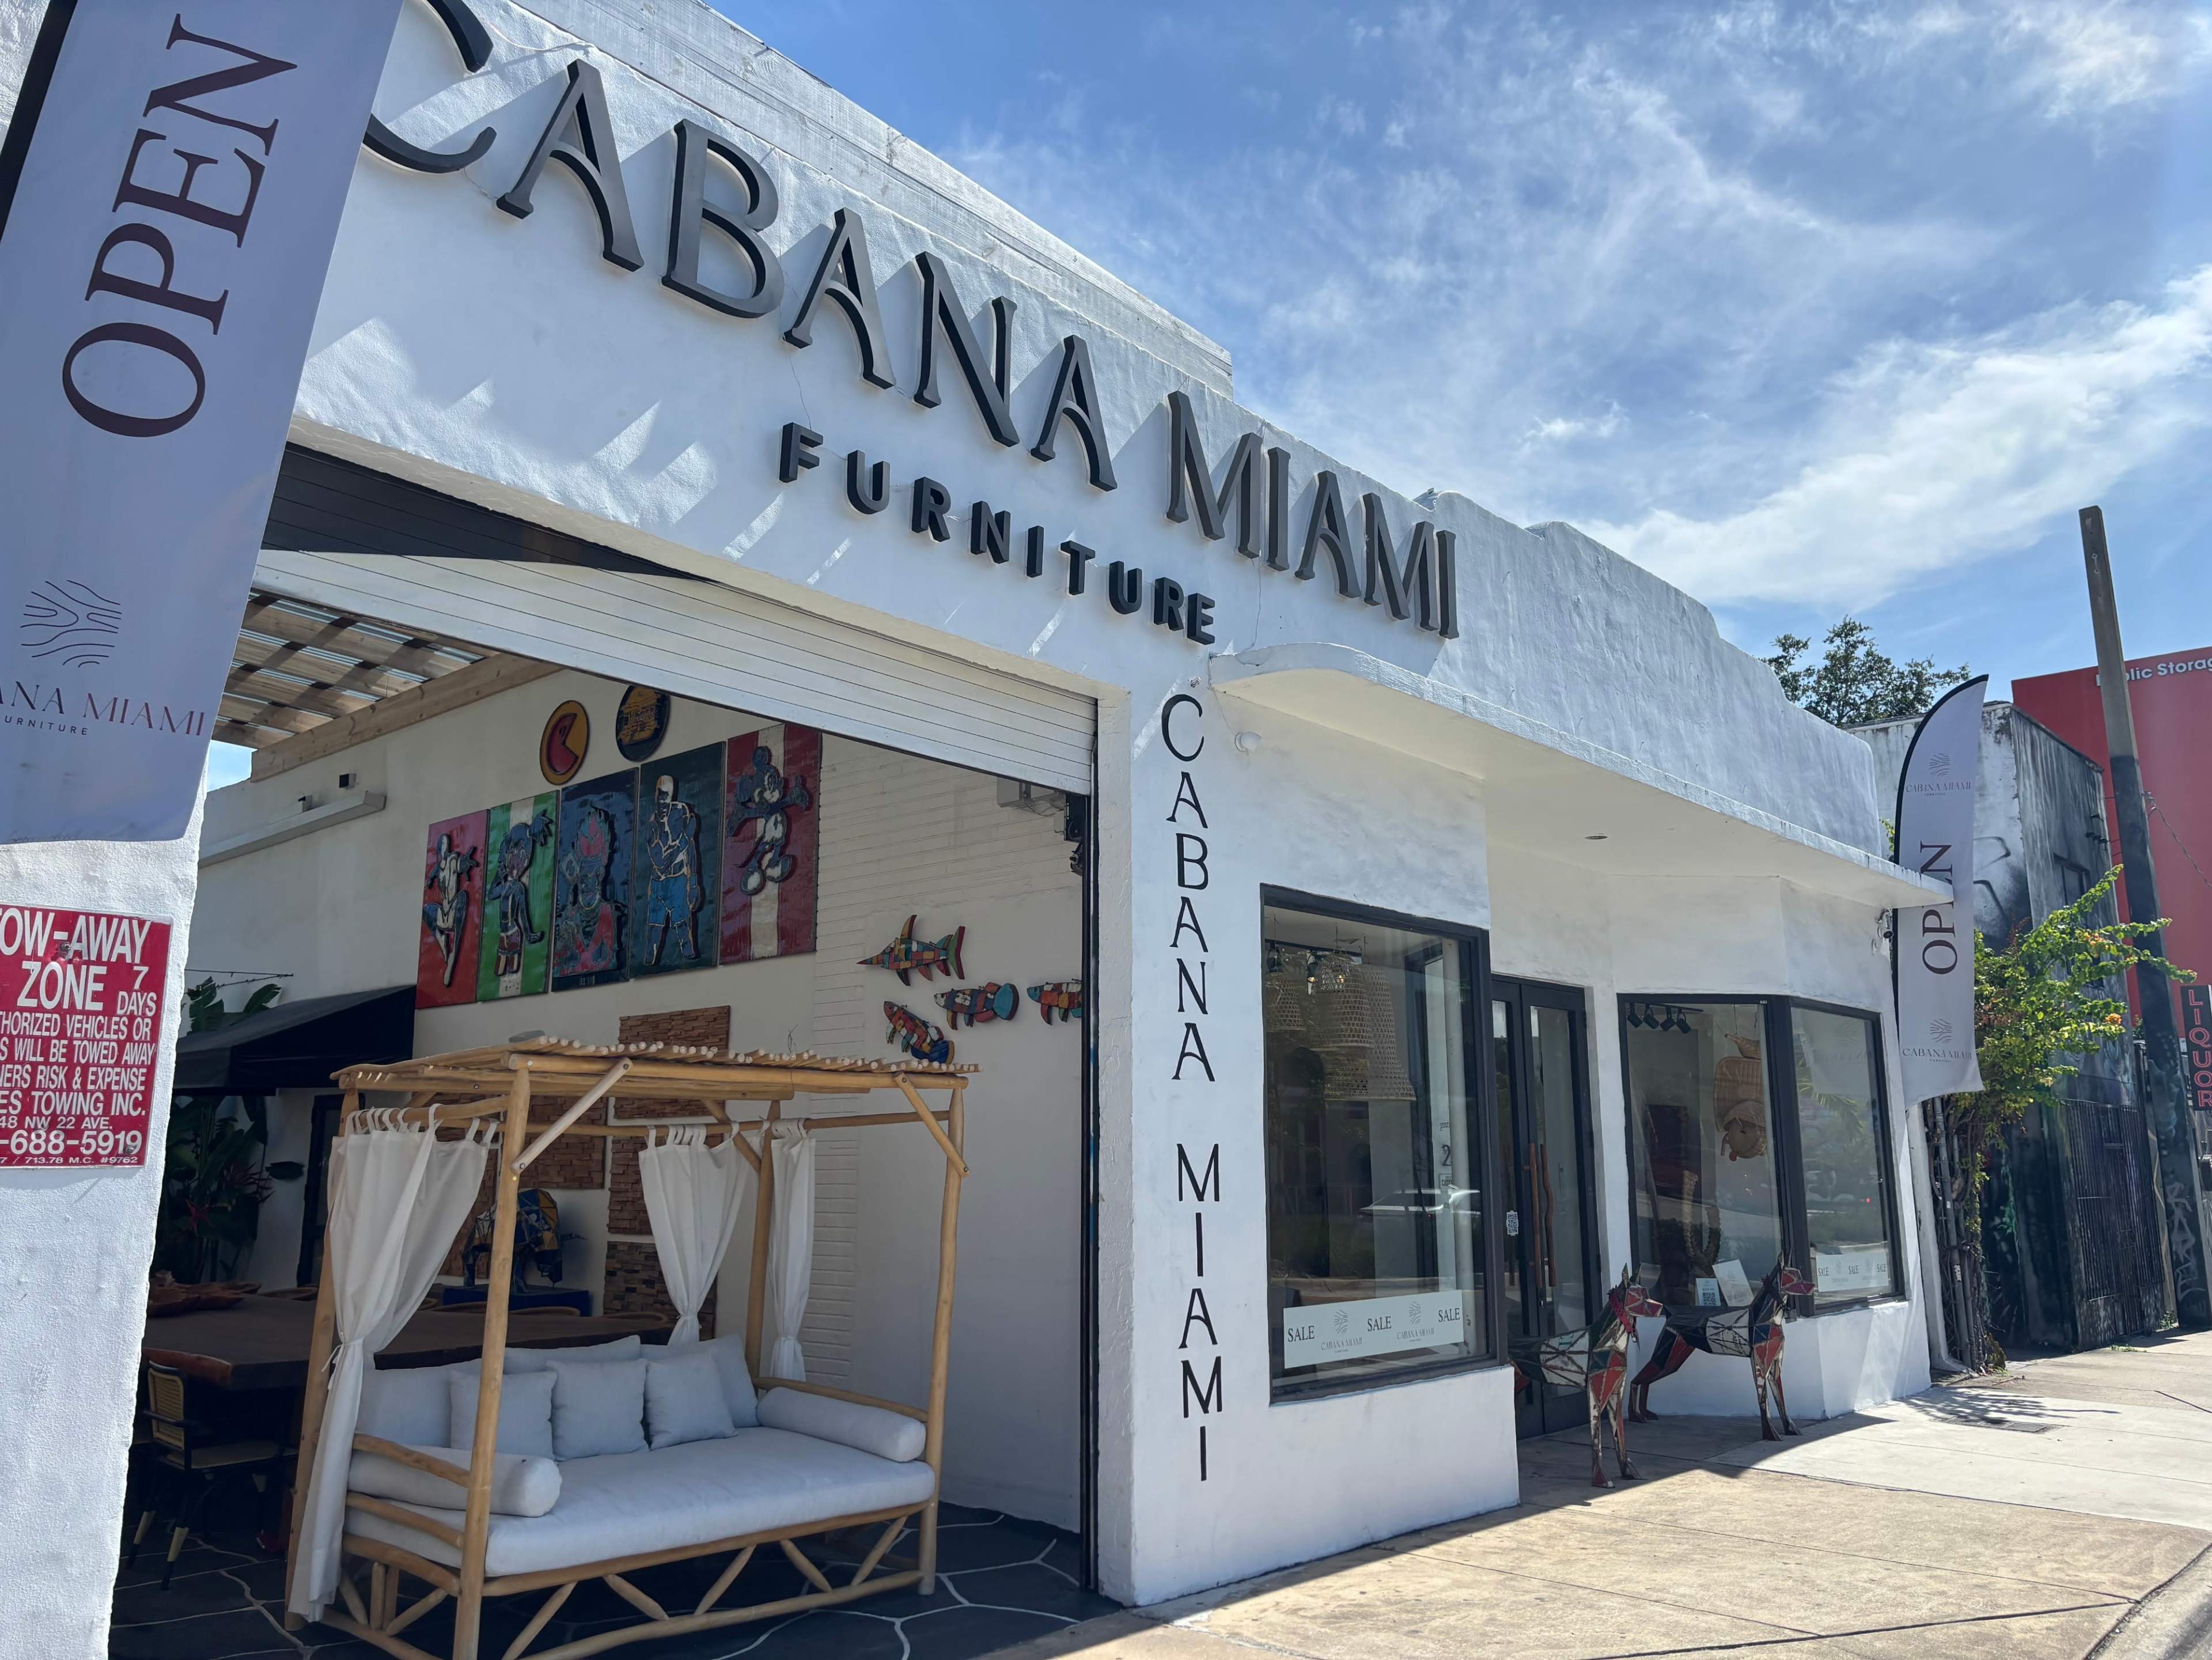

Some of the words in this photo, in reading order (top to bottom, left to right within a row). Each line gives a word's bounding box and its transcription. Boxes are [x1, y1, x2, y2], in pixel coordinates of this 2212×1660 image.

[62, 13, 297, 438] OPEN
[779, 422, 1215, 646] FURNITURE
[1166, 390, 1459, 640] MIAMI
[83, 693, 206, 736] MIAMI
[1161, 694, 1215, 1082] CABANA
[1920, 840, 1958, 974] OPN
[0, 907, 151, 964] OW-AWAY
[17, 961, 107, 1011] ZONE
[132, 966, 149, 990] 7
[116, 991, 157, 1016] DAYS
[66, 1014, 128, 1040] VEHICLES
[132, 1018, 152, 1041] OR
[2188, 989, 2212, 1107] LIQUOR
[14, 1038, 44, 1062] WILL
[49, 1039, 69, 1062] BE
[73, 1040, 118, 1064] TOWED
[122, 1042, 156, 1065] AWAY
[36, 1065, 68, 1089] RISK
[72, 1066, 82, 1090] &
[88, 1067, 147, 1091] EXPENSE
[25, 1116, 51, 1129] NW
[56, 1116, 75, 1129] 22
[81, 1117, 113, 1130] AVE.
[31, 1090, 104, 1116] TOWING
[111, 1092, 146, 1117] INC.
[1176, 1143, 1222, 1481] MIAMI
[1287, 1325, 1315, 1343] SALE
[1367, 1316, 1392, 1332] SALE
[1438, 1307, 1460, 1323] SALE
